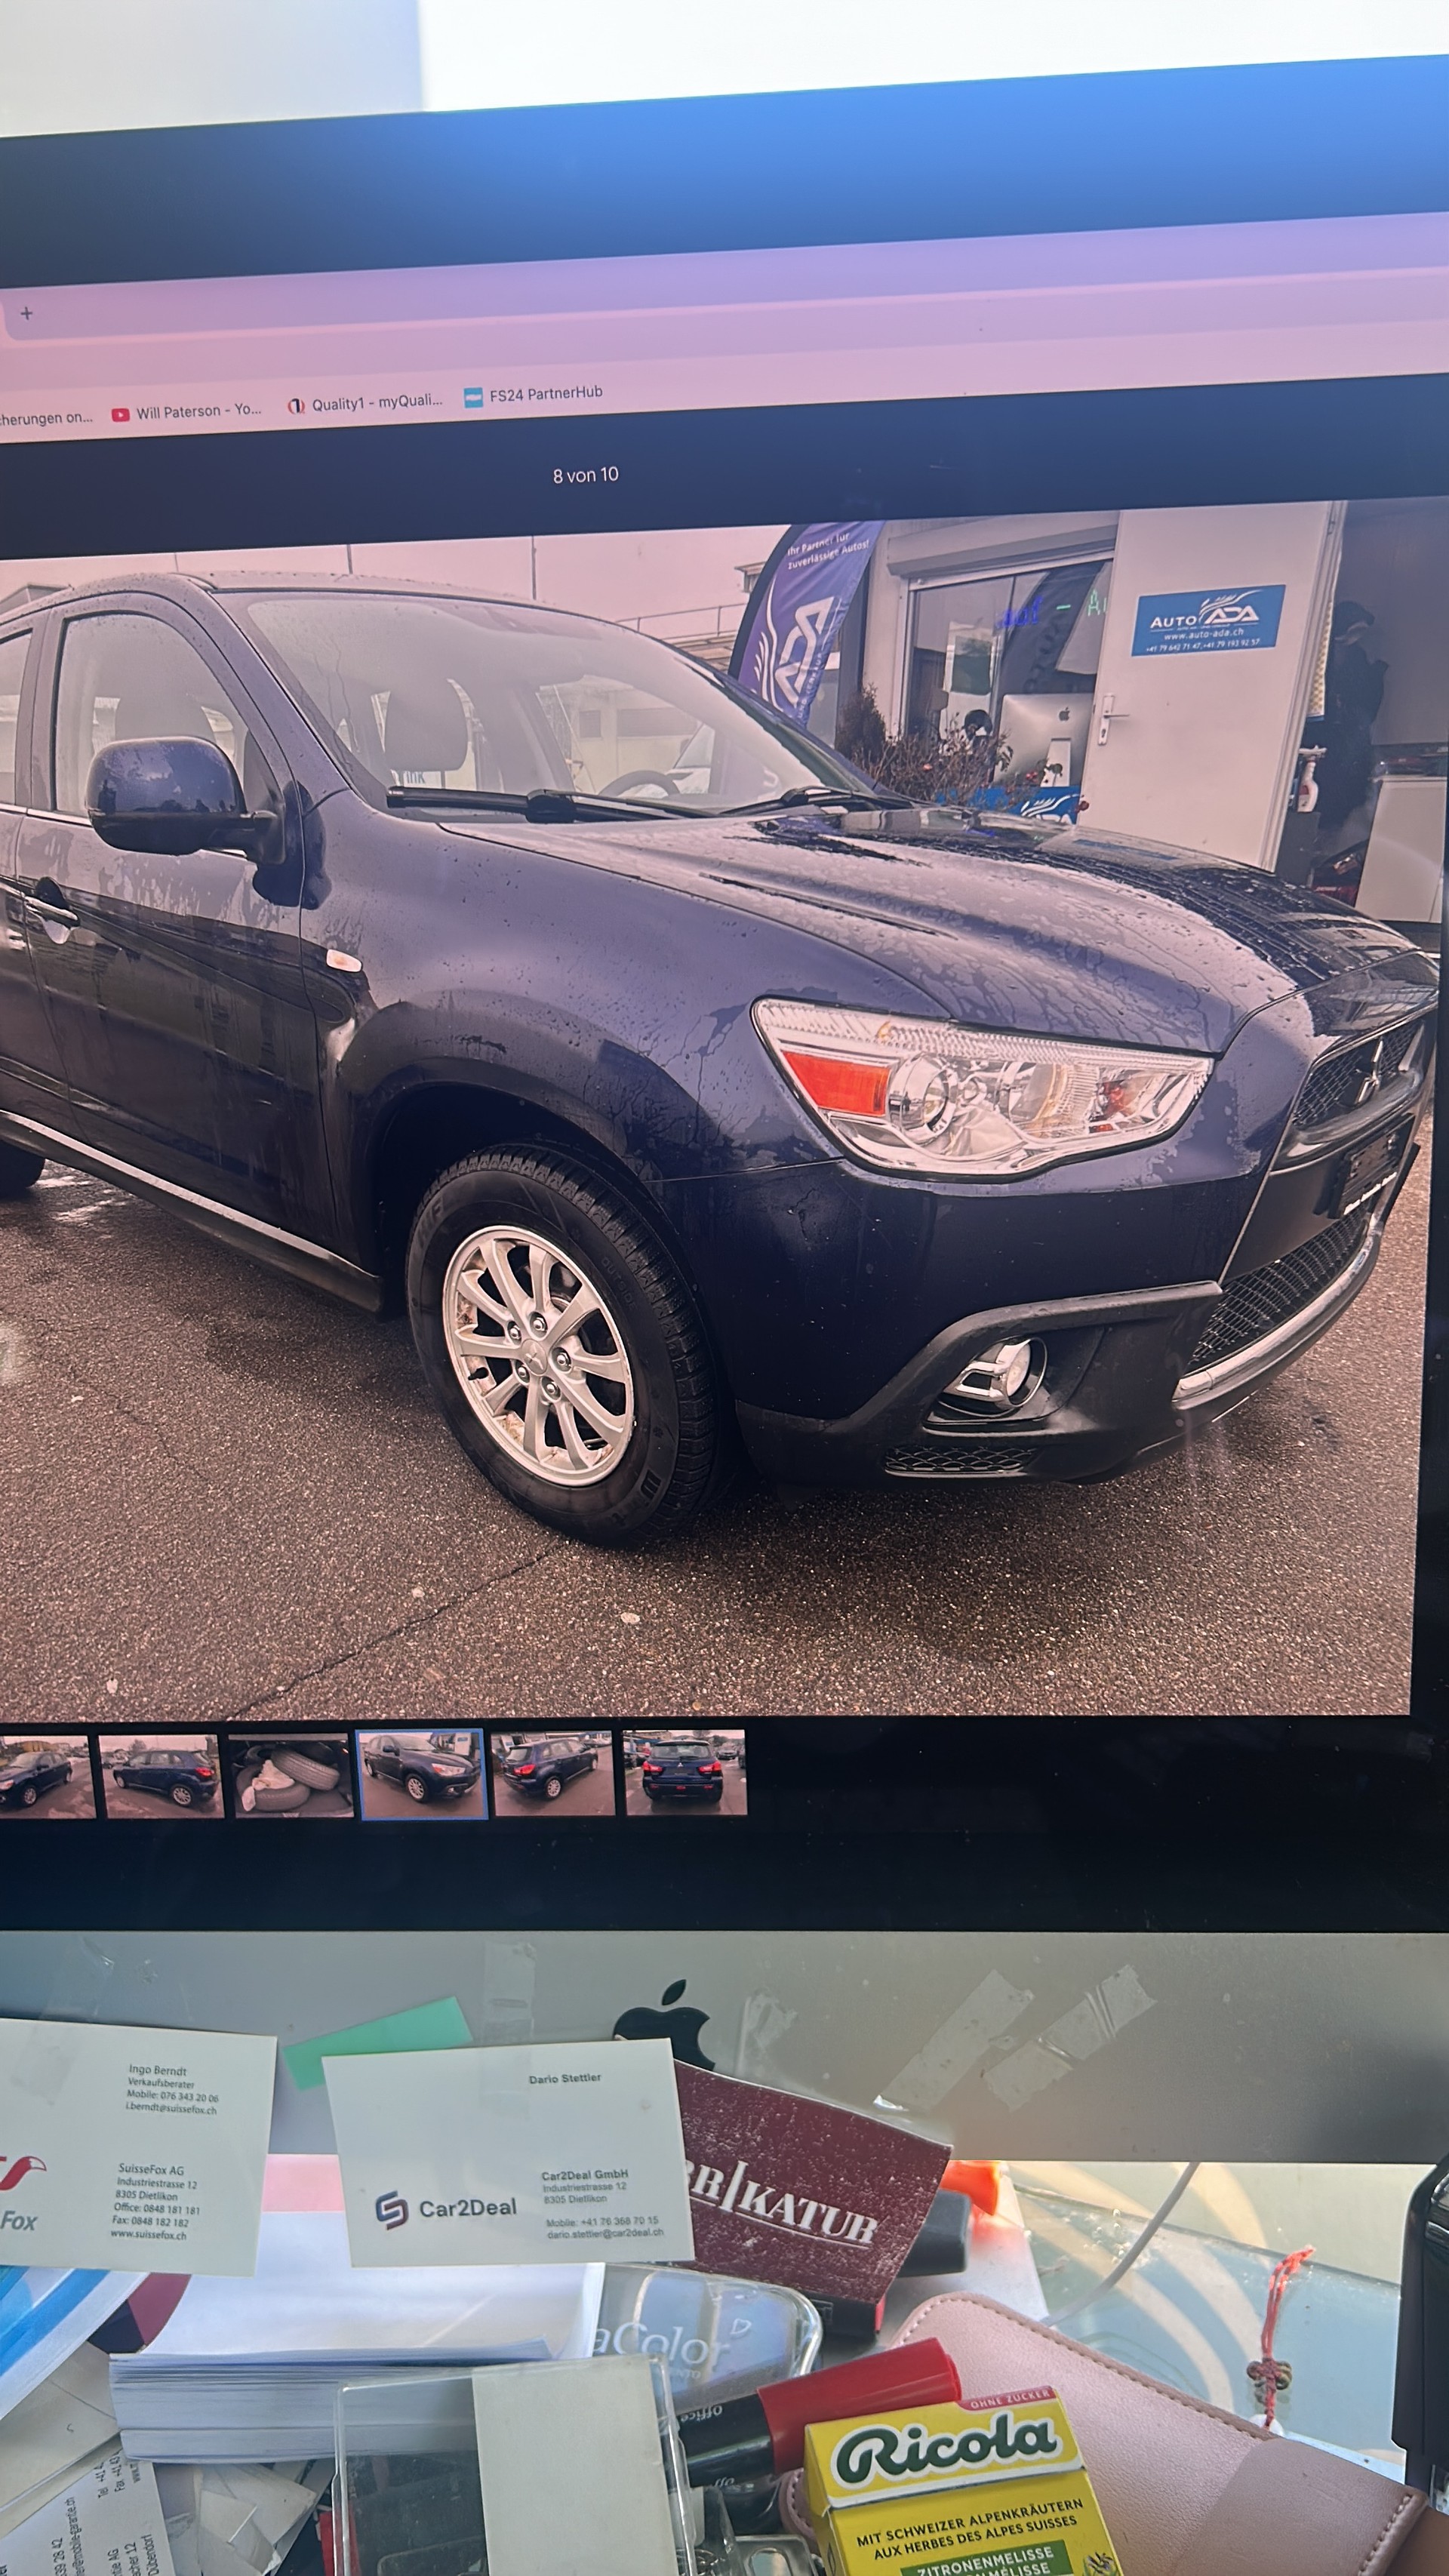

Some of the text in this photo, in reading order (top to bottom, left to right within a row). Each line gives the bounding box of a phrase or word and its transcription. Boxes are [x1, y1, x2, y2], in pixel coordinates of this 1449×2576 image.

[491, 385, 603, 402] FS24 PartnerHub
[312, 399, 364, 413] Quality1
[379, 395, 443, 409] myQuali...
[137, 407, 160, 420] Will
[165, 405, 220, 419] Paterson
[235, 404, 262, 416] Yo...
[553, 466, 619, 484] 8 von 10
[1150, 616, 1197, 628] AUTO
[1204, 605, 1260, 624] ADA
[1164, 627, 1244, 640] www.auto-ada.ch
[129, 2064, 187, 2077] Ingo Berndt
[128, 2077, 195, 2089] Verkaufsberater
[529, 2073, 601, 2085] Dario Stettler
[127, 2089, 158, 2100] Mobile:
[161, 2091, 177, 2101] 076
[178, 2092, 194, 2102] 343
[196, 2094, 207, 2103] 20
[118, 2162, 185, 2176] SuisseFox AG
[542, 2168, 629, 2181] Car2Deal GmbH
[117, 2177, 198, 2190] Industriestrasse 12
[543, 2181, 627, 2193] Industriestrasse 12
[115, 2190, 178, 2202] 8305 Dietlikon
[544, 2194, 608, 2204] 8305 Dietlikon
[114, 2202, 200, 2215] Office: 0848 181 181
[419, 2197, 518, 2218] Car2Deal
[0, 2210, 38, 2231] Fox
[112, 2215, 189, 2227] Fax: 0848 182 182
[546, 2218, 578, 2227] Mobile:
[111, 2229, 187, 2241] www.suissefox.ch
[971, 2389, 1051, 2410] OHNE ZUCKER
[835, 2413, 1057, 2483] Ricola
[97, 2486, 109, 2498] Tel
[114, 2480, 125, 2493] Fax
[857, 2498, 1084, 2549] MIT SCHWEIZER ALPENKRÄUTERN
[51, 2537, 63, 2549] 42
[874, 2514, 1078, 2561] AUX HERBES DES ALPES SUISSES
[125, 2541, 137, 2554] 12
[108, 2548, 119, 2561] AG
